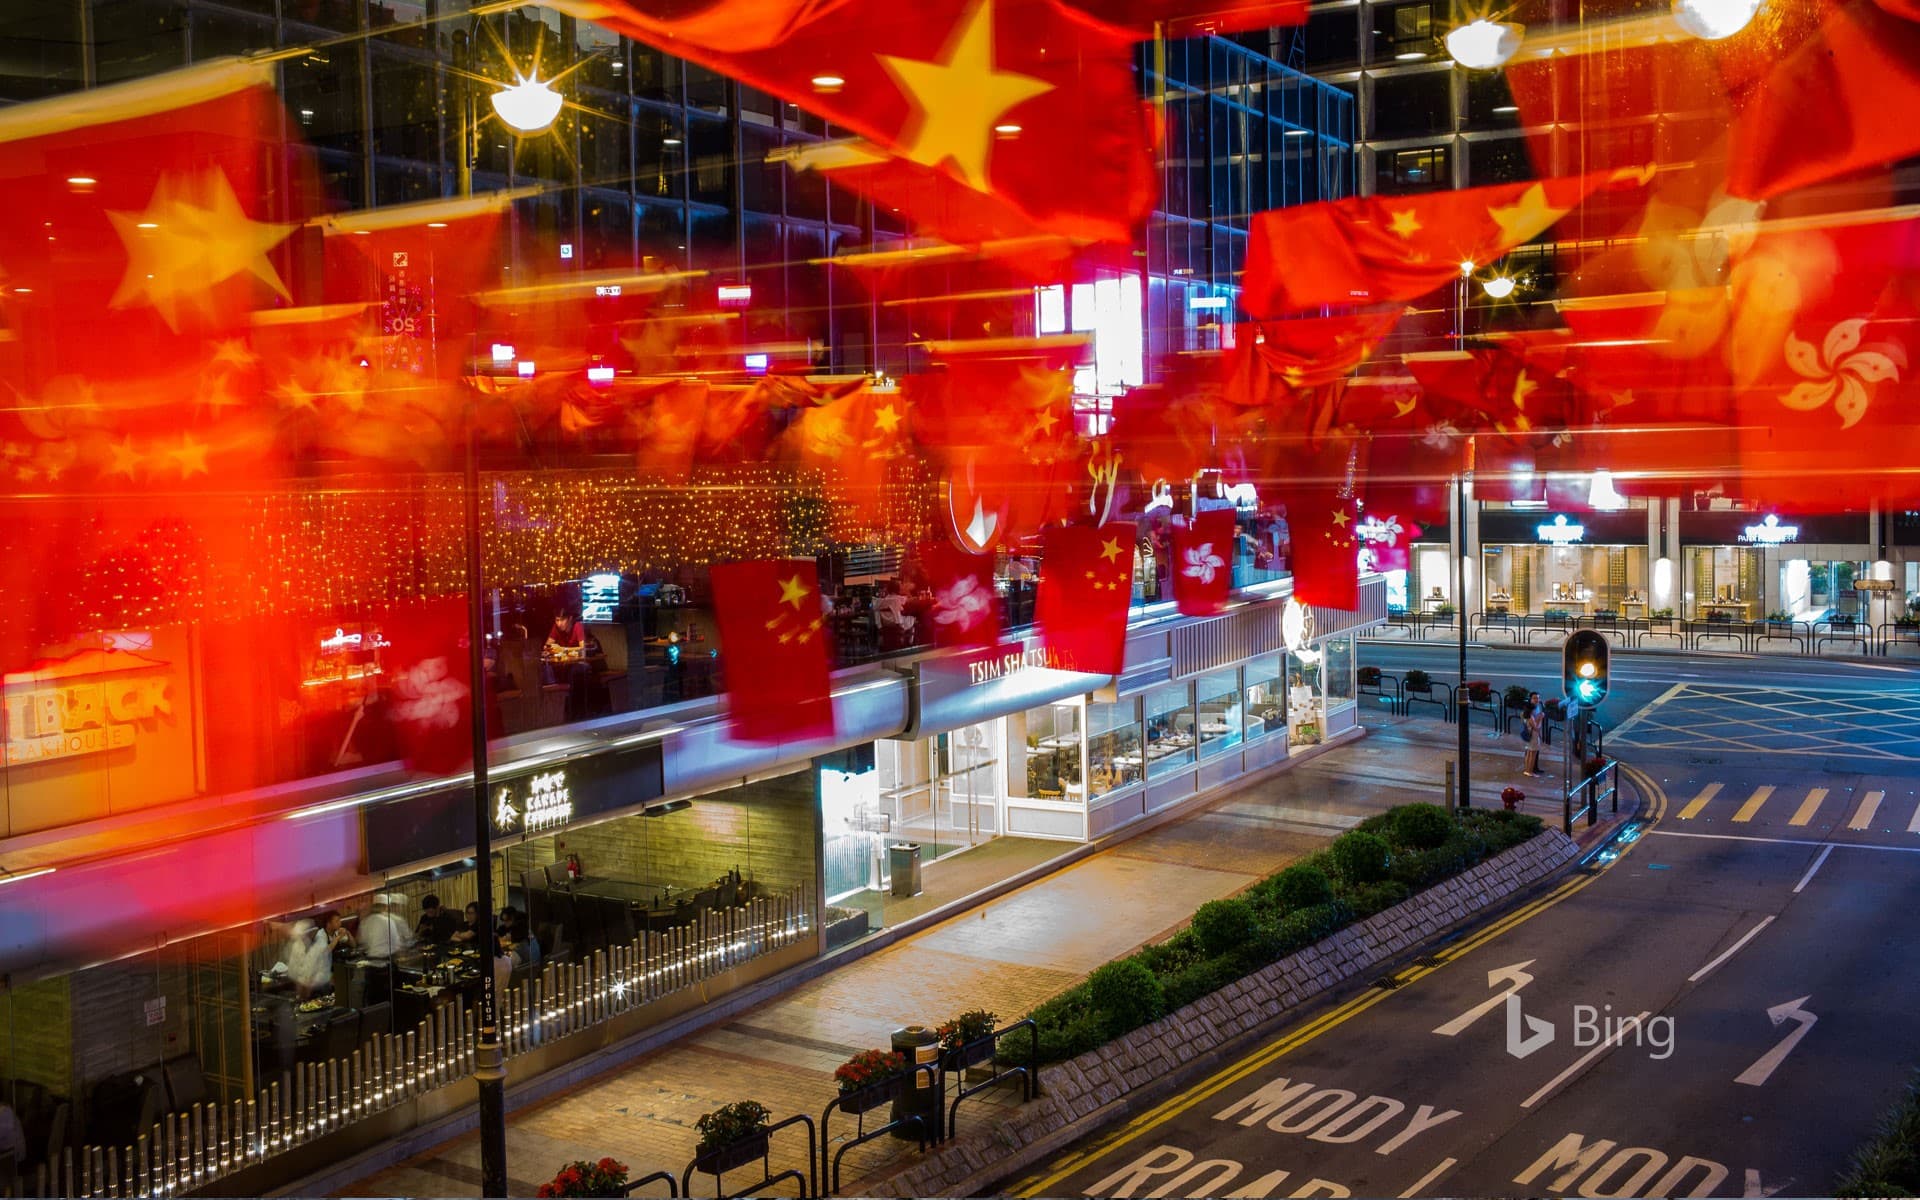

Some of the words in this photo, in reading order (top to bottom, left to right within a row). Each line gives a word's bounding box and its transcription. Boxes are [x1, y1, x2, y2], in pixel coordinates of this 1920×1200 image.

[969, 658, 1001, 683] TSIM
[1004, 652, 1028, 676] SHA
[1211, 1077, 1463, 1155] MODY
